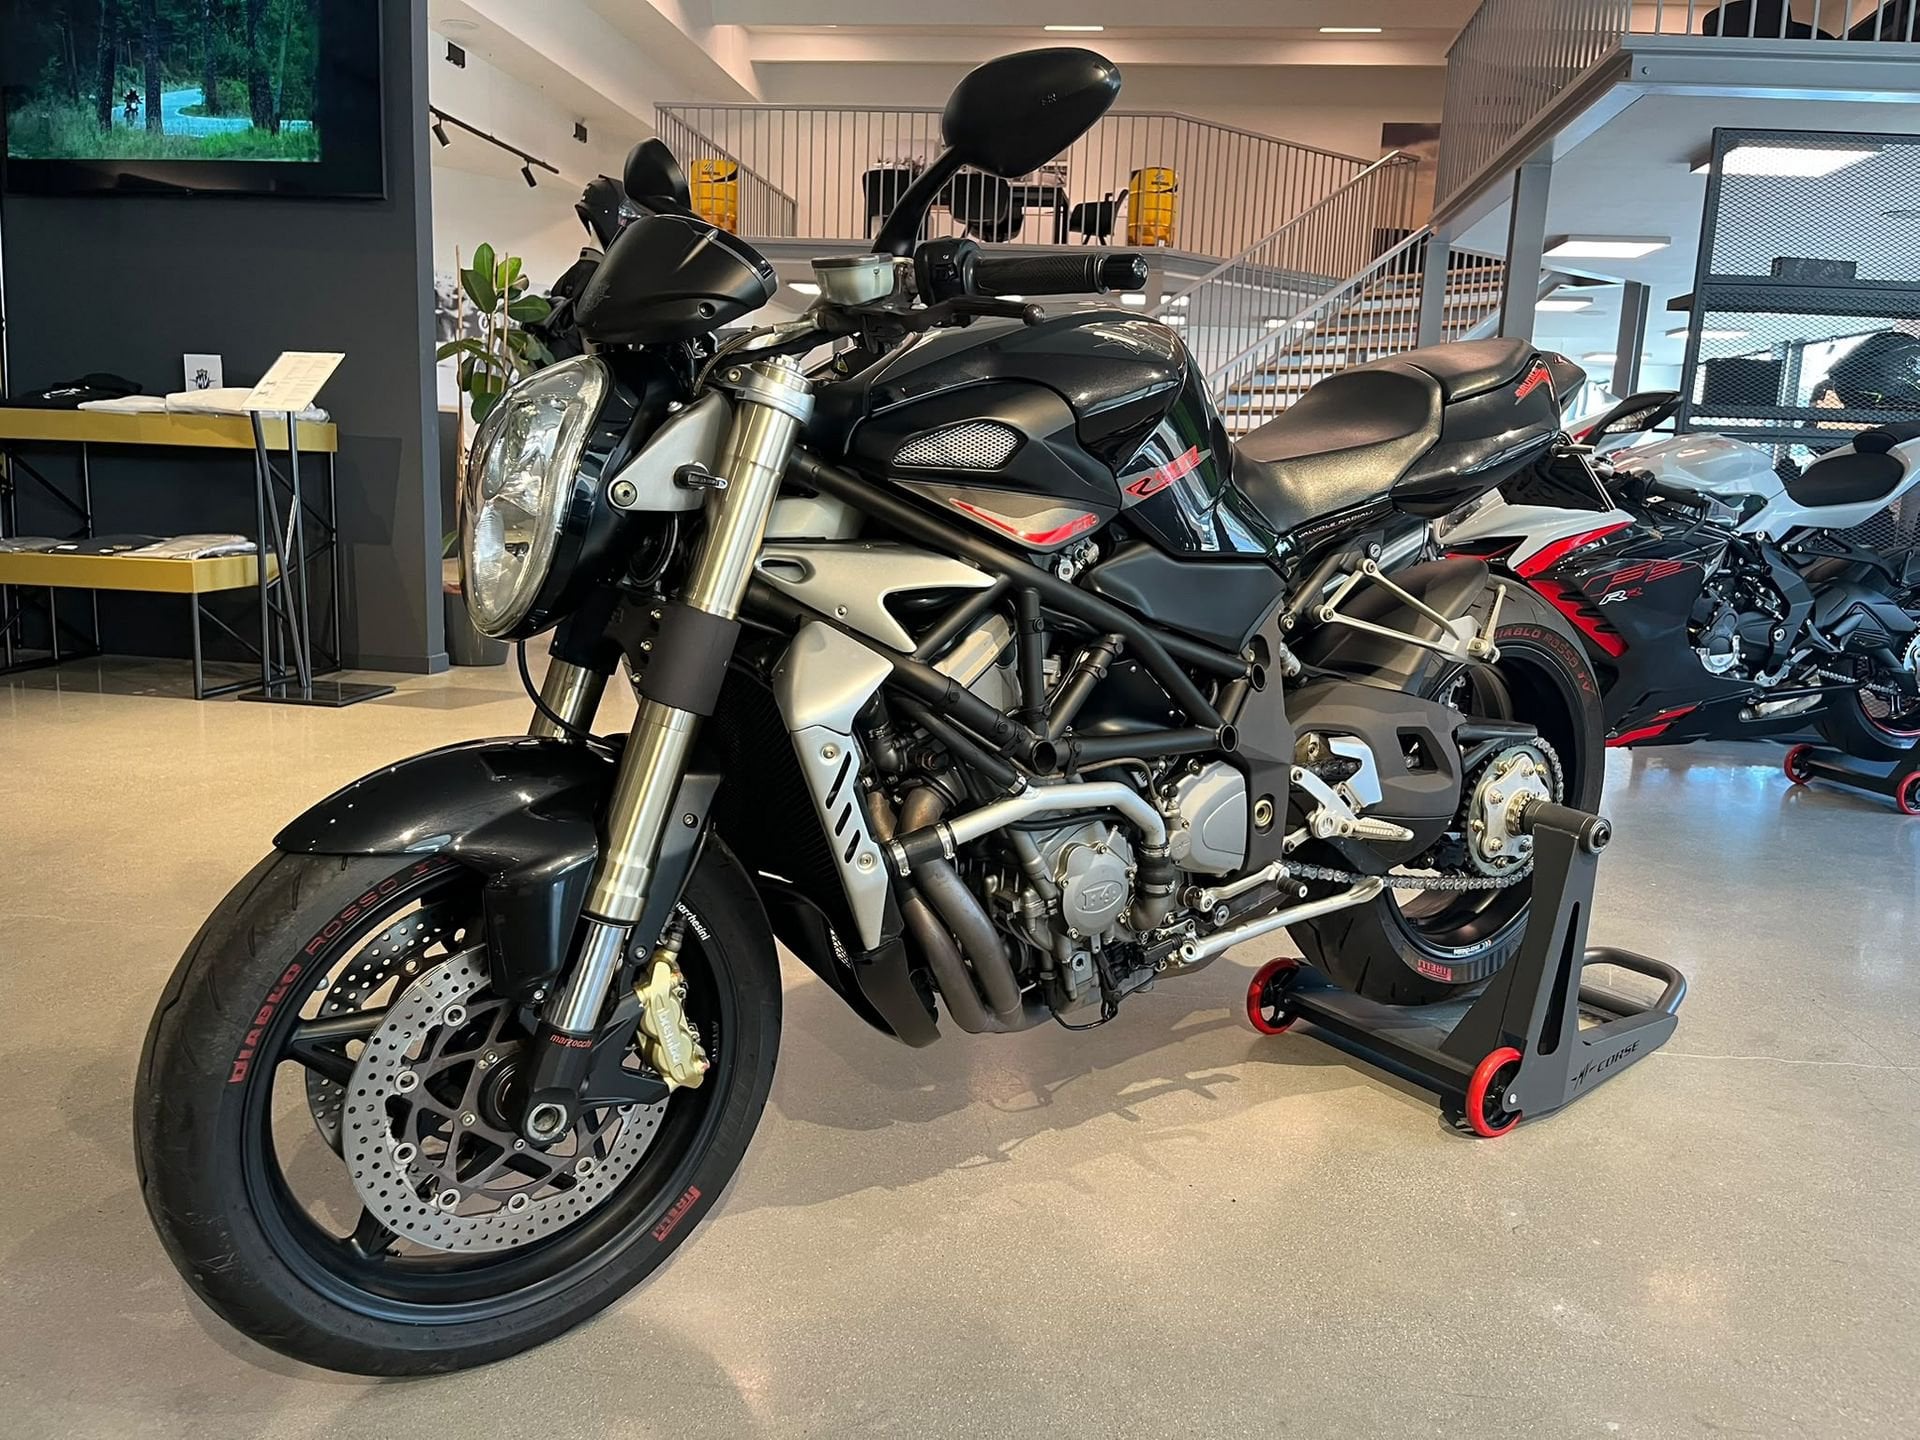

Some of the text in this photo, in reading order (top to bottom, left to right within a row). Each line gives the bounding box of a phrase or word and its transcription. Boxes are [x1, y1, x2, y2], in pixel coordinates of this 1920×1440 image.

[1543, 633, 1578, 669] ROSSO
[229, 963, 302, 1084] DIABLO
[305, 877, 398, 956] ROSSO
[549, 1034, 593, 1048] marzocchi
[1597, 1040, 1640, 1073] CORSE
[651, 1185, 702, 1242] PIRELLI
